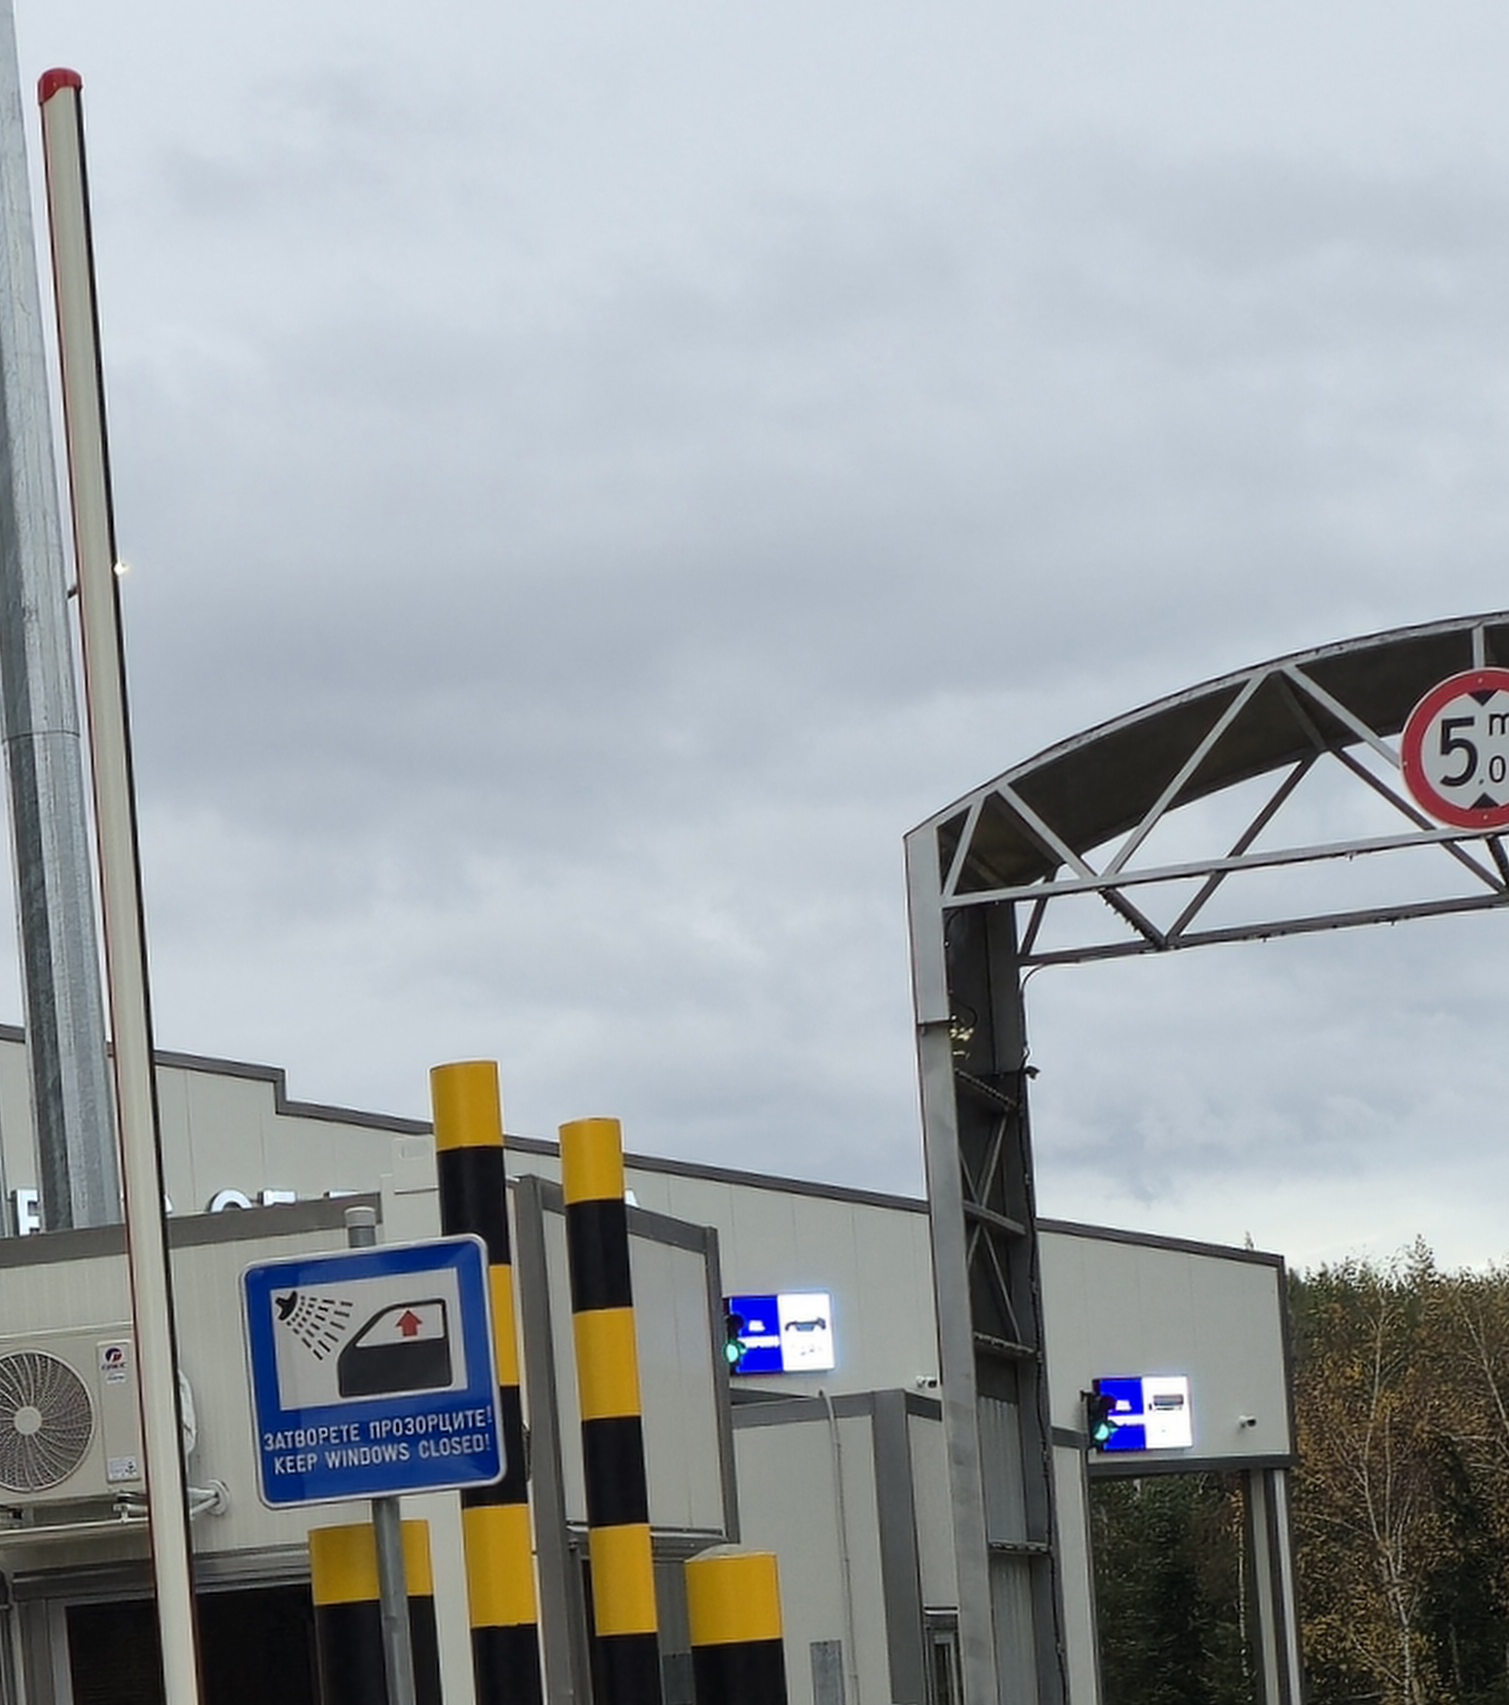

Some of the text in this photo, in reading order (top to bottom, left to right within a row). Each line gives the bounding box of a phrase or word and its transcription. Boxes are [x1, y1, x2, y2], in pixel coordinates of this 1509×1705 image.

[264, 1405, 493, 1451] ЗАТВОРЕТЕ ПРОЗОРЦИТЕ!
[274, 1433, 491, 1476] KEEP WINDOWS CLOSED!
